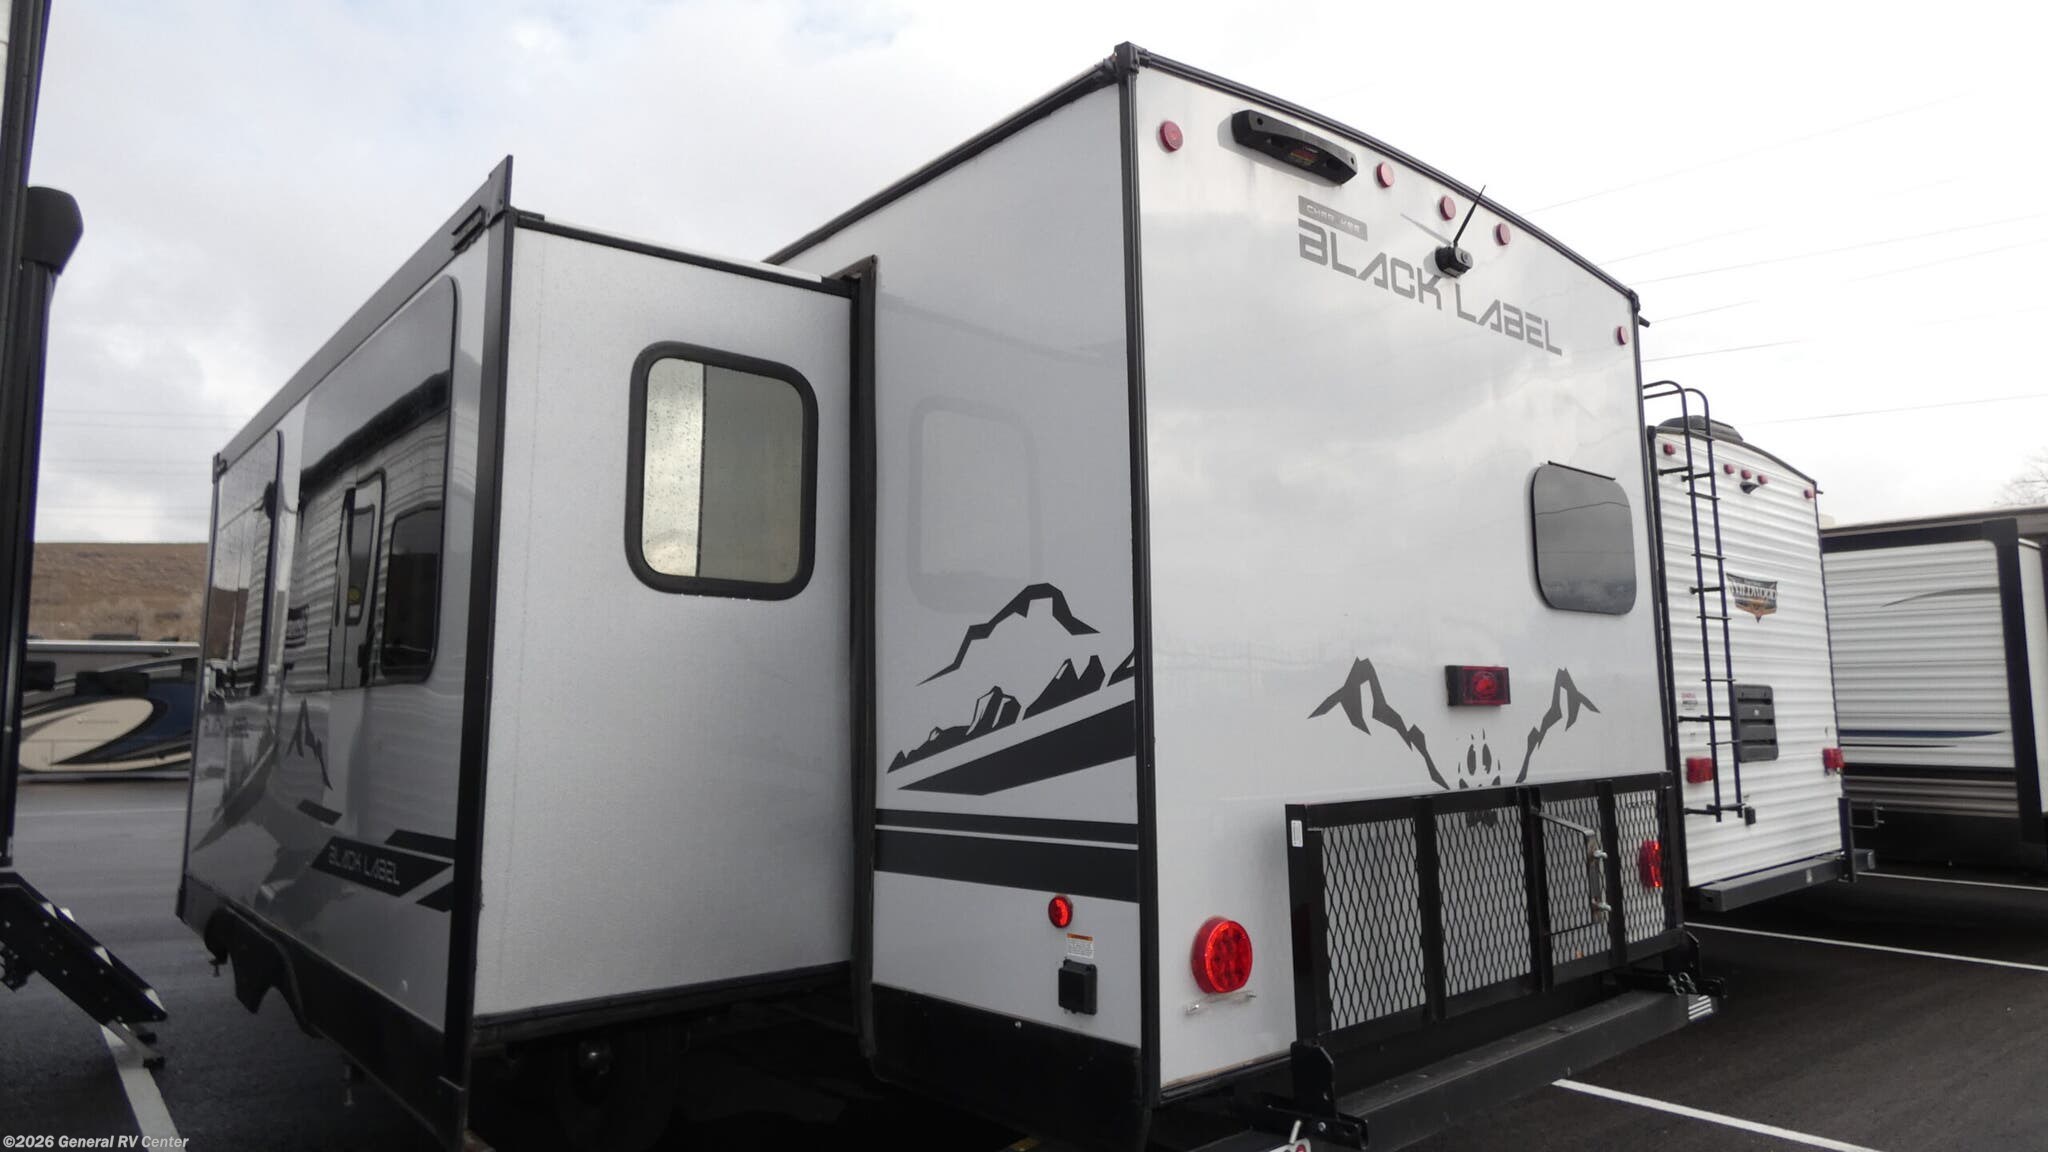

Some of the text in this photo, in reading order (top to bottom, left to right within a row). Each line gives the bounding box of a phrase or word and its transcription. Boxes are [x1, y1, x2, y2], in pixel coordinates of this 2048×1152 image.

[1297, 217, 1563, 356] BLACK LABEL
[363, 853, 401, 886] LABEL
